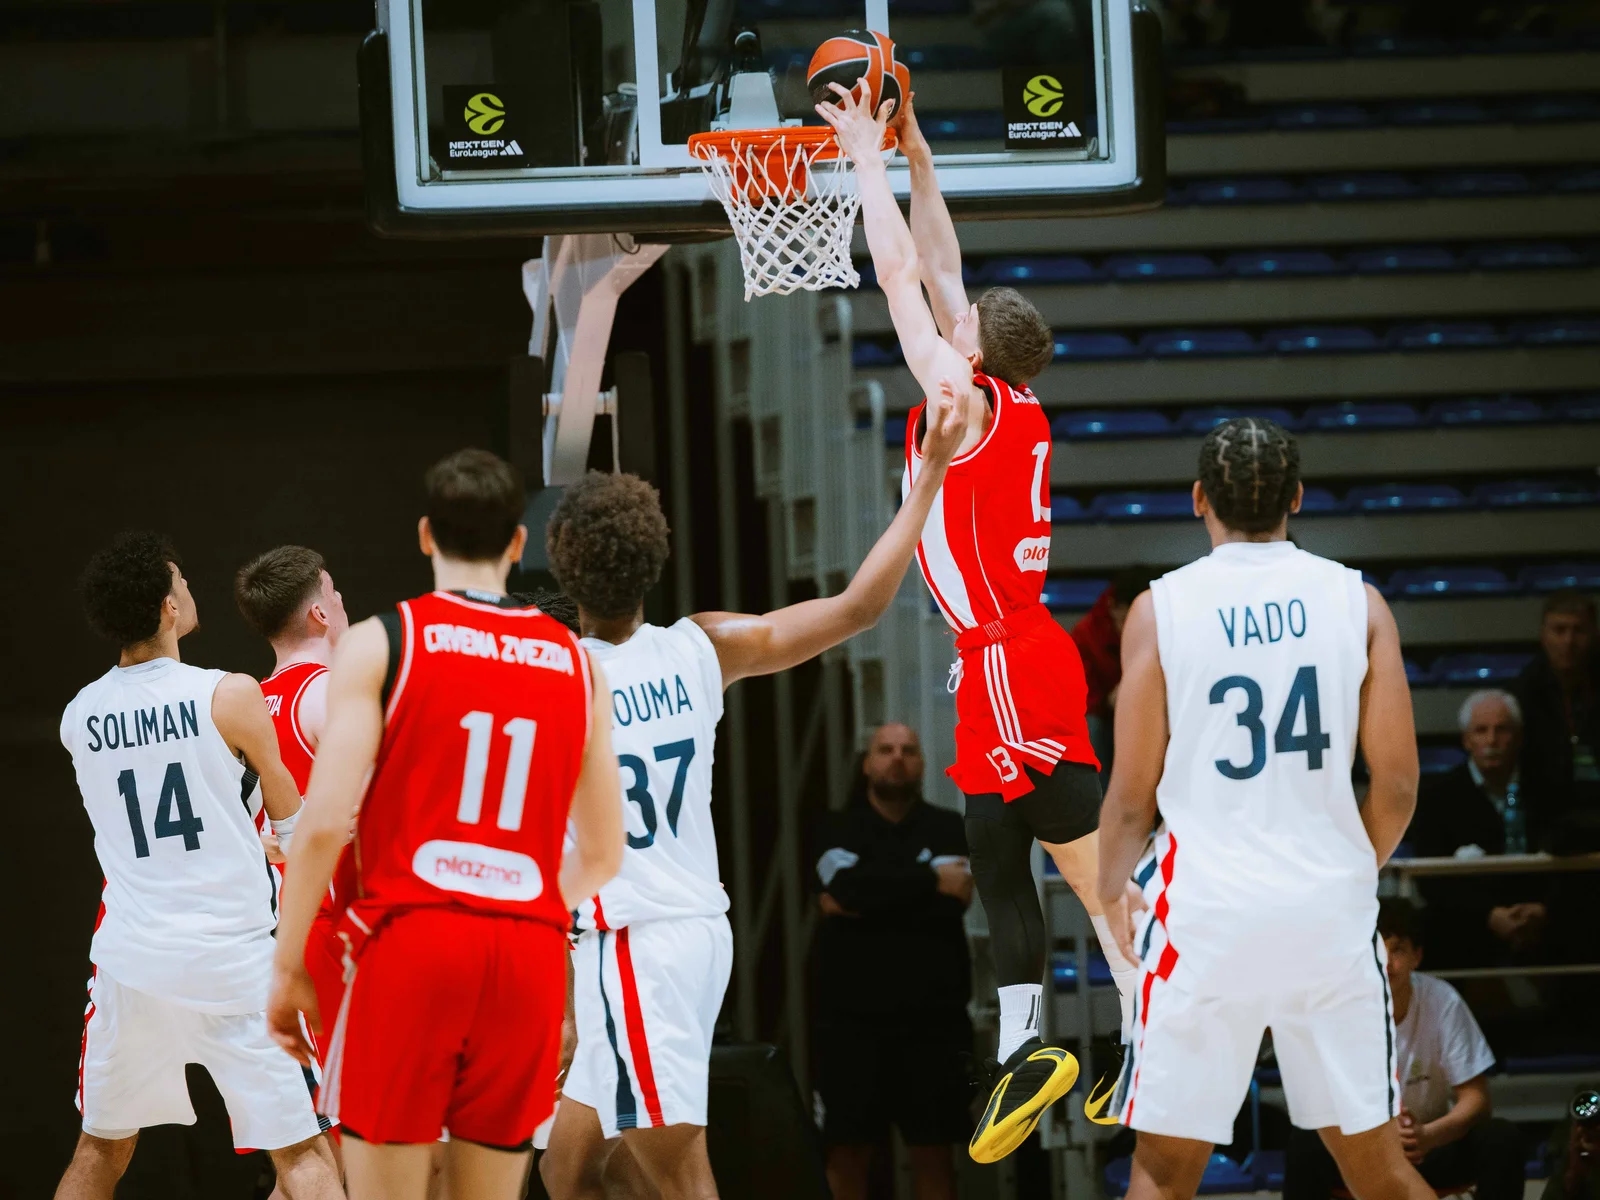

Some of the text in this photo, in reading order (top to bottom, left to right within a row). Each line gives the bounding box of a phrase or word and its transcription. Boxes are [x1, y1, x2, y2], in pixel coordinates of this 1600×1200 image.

[449, 148, 498, 159] EuroLeague
[1008, 130, 1057, 141] EuroLeague
[423, 623, 575, 677] CRVENA ZVEZDA
[1217, 599, 1307, 648] VADO
[86, 699, 200, 753] SOLIMAN
[611, 674, 694, 727] OUMA
[1208, 665, 1331, 781] 34
[456, 709, 538, 833] 11
[985, 745, 1019, 785] 13
[116, 761, 205, 859] 14
[617, 737, 696, 850] 37
[434, 855, 522, 886] plazma
